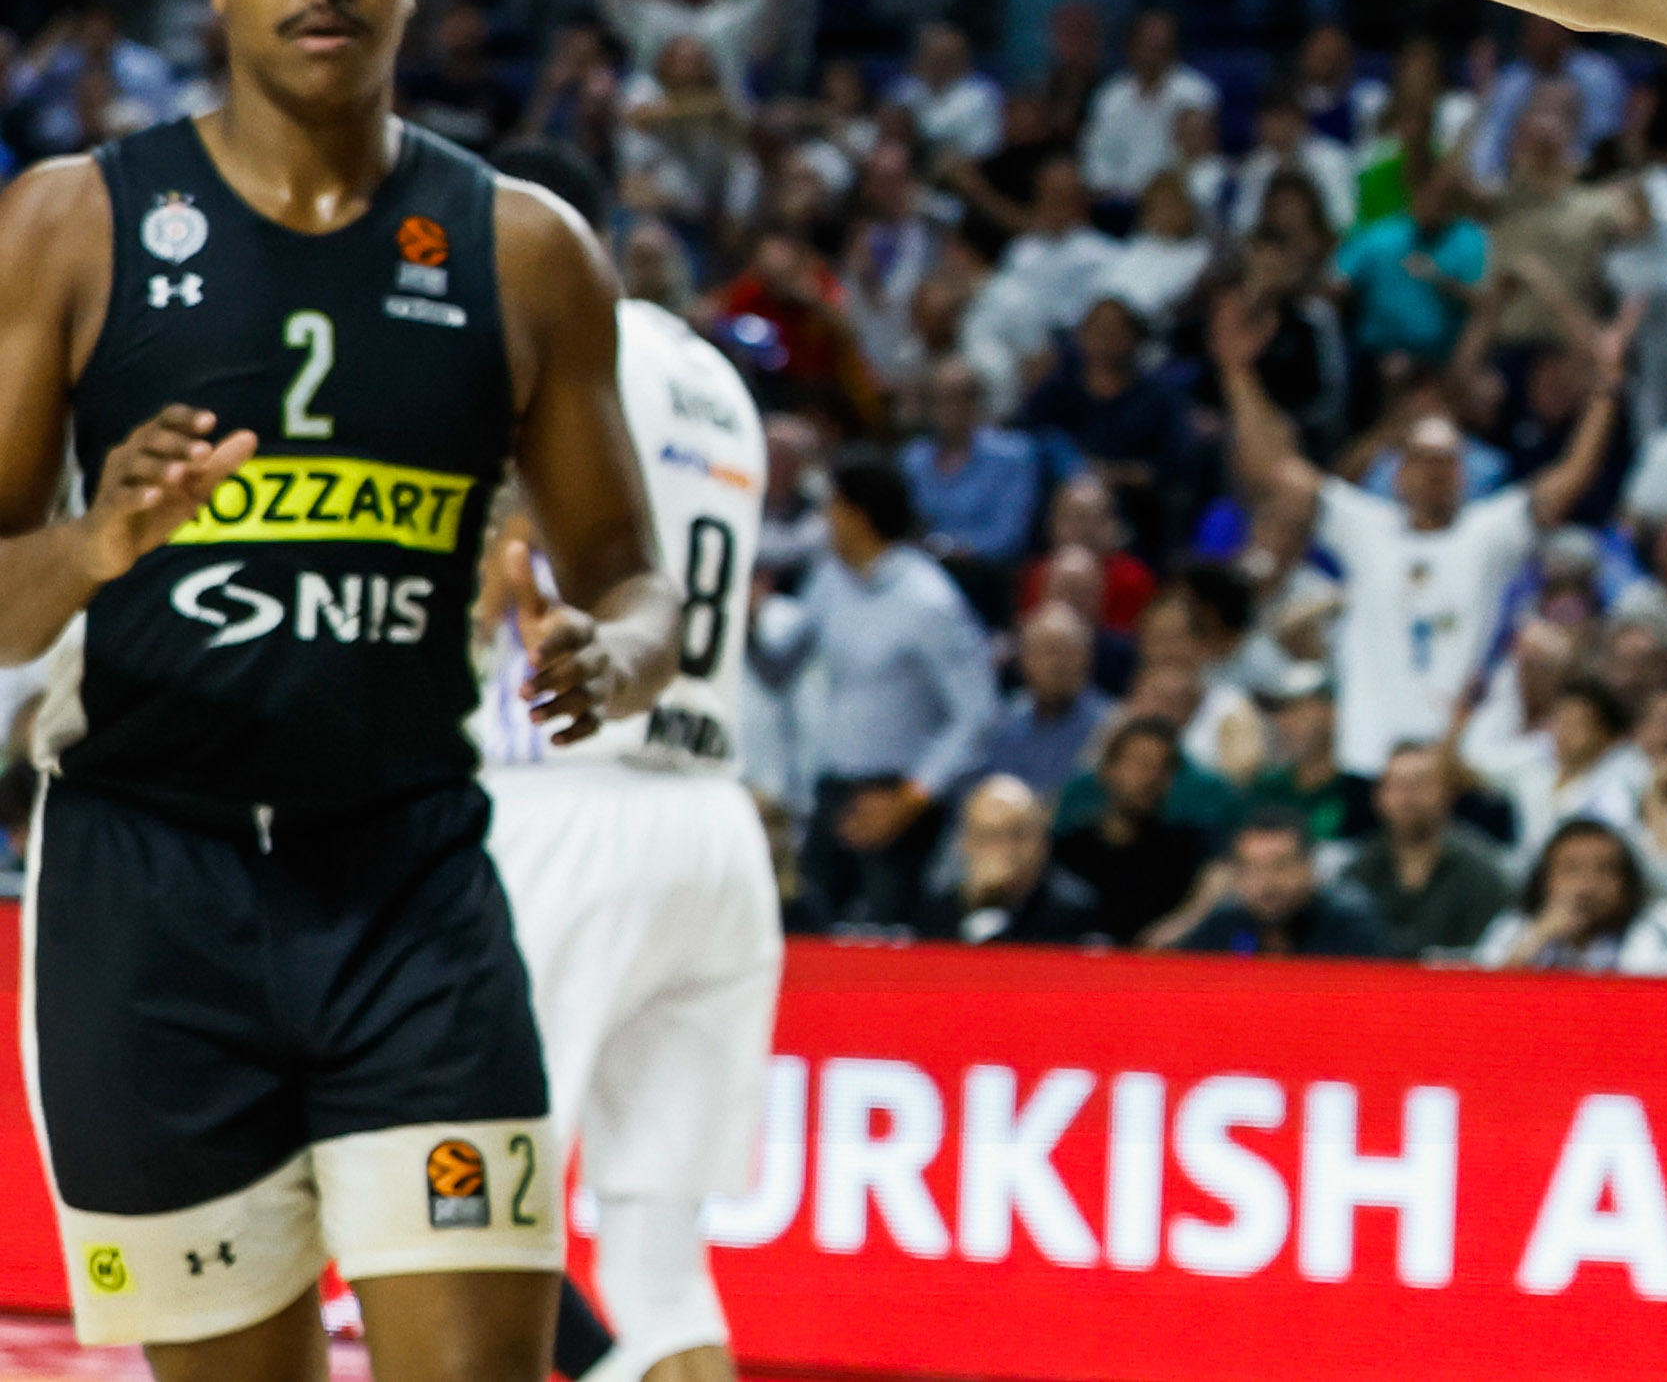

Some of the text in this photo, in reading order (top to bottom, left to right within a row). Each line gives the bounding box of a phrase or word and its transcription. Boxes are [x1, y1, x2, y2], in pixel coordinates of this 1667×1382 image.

[280, 310, 336, 440] 2
[192, 472, 458, 535] OZZART
[295, 571, 435, 644] NIS
[678, 514, 737, 678] 8
[508, 1134, 537, 1226] 2
